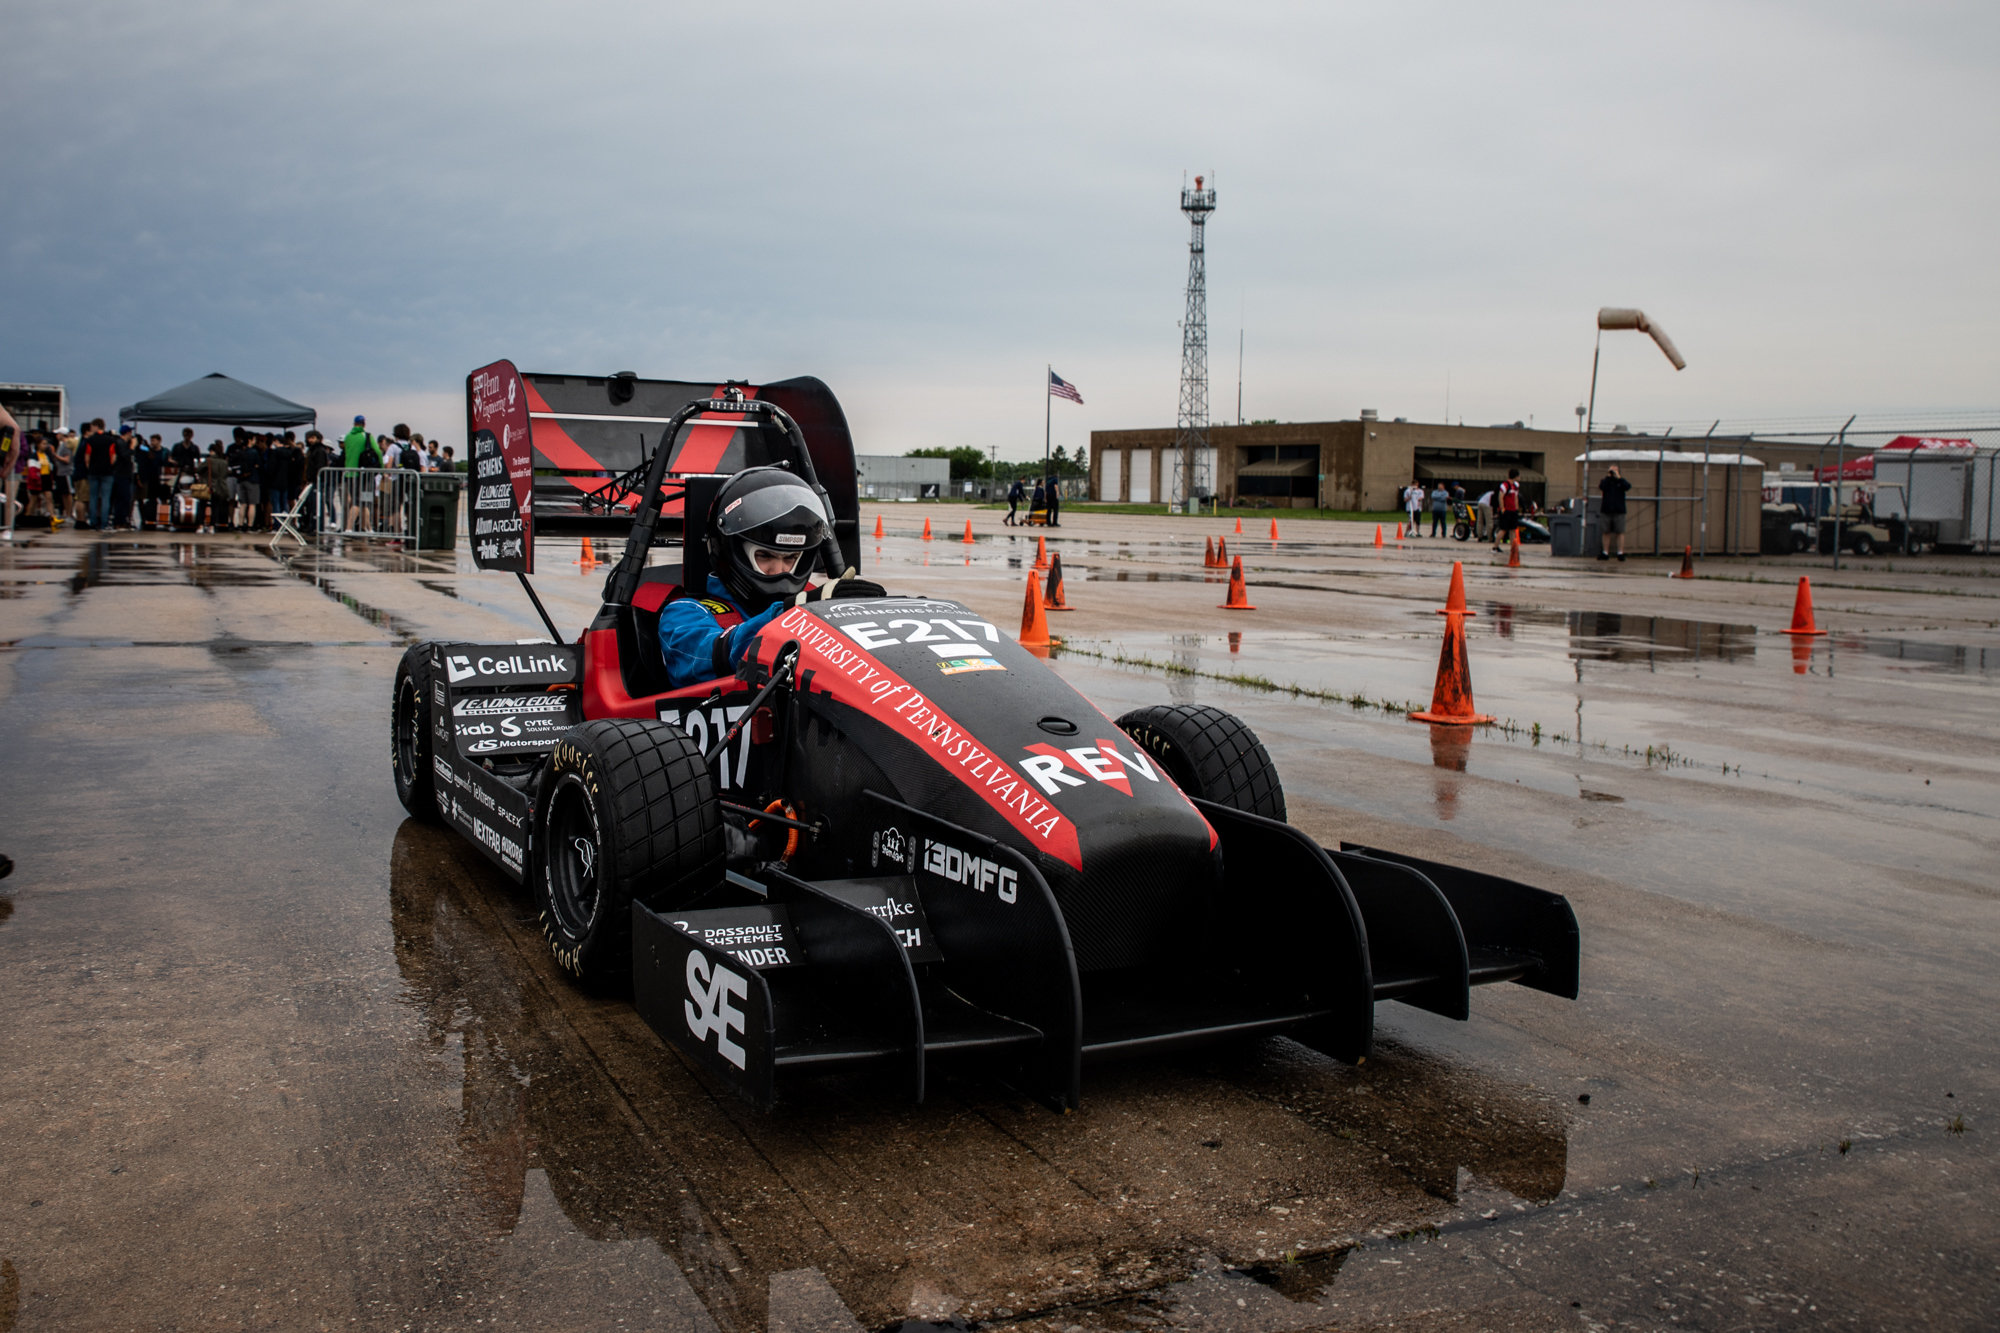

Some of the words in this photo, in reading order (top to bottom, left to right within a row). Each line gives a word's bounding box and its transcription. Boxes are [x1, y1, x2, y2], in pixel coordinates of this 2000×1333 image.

[483, 372, 500, 398] Penn
[482, 395, 506, 422] Engineering
[477, 456, 503, 479] SIEMENS
[499, 483, 512, 499] EDGE
[777, 535, 805, 544] SIMPSON
[840, 618, 1000, 651] E217
[477, 655, 567, 675] CelLink
[454, 697, 527, 710] LEADING
[525, 695, 568, 707] EDGE
[464, 706, 563, 716] COMPOSITES
[524, 719, 554, 727] CYTEC
[781, 608, 880, 685] UNIVERSITY
[870, 679, 911, 705] of
[894, 692, 1061, 839] PENNSYLVANIA
[554, 739, 599, 796] Hoosier
[1018, 746, 1160, 796] REV
[473, 782, 496, 811] TeXtreme
[497, 806, 524, 828] SPACEX
[473, 816, 500, 854] NEXTFAB
[501, 835, 523, 864] AURORA
[704, 924, 782, 939] DASSAULT
[705, 933, 784, 946] SYSTEMES
[726, 947, 791, 967] NDER
[684, 949, 748, 1071] SAE
